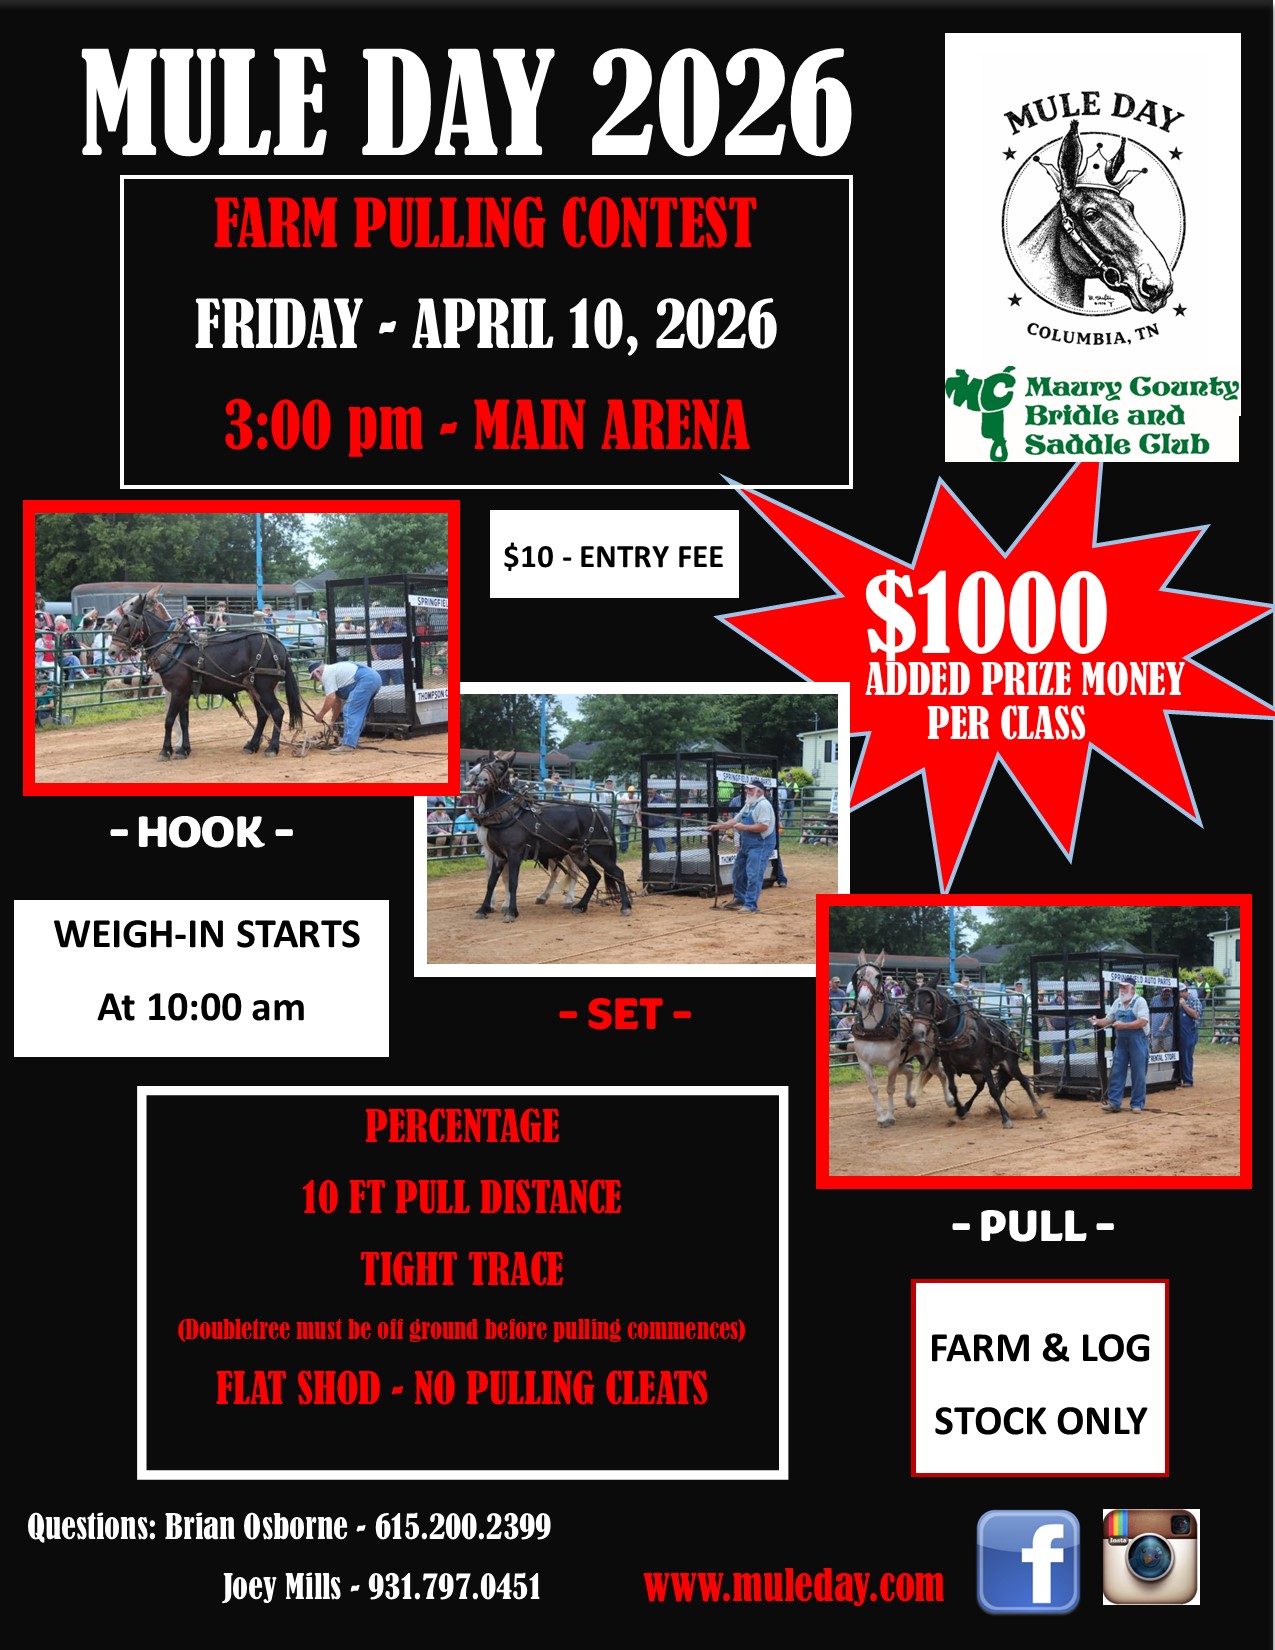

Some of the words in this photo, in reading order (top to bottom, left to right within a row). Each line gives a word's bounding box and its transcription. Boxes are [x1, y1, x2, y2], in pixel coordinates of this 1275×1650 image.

[82, 49, 327, 156] MULE
[362, 49, 555, 155] DAY
[592, 48, 852, 156] 2026
[1003, 90, 1102, 135] MULE
[1111, 91, 1186, 133] DAY
[214, 197, 337, 247] FARM
[354, 197, 546, 248] PULLING
[563, 197, 756, 248] CONTEST
[195, 298, 363, 348] FRIDAY
[412, 298, 553, 348] APRIL
[570, 298, 638, 356] 10,
[656, 298, 777, 349] 2026
[1026, 322, 1132, 346] COLUMBIA,
[1135, 322, 1160, 341] TN
[1025, 377, 1122, 401] Maury
[1129, 376, 1240, 401] County
[225, 399, 331, 450] 3:00
[348, 406, 423, 457] pm
[474, 399, 585, 449] MAIN
[601, 399, 750, 449] ARENA
[1025, 404, 1119, 426] Bridle
[1127, 404, 1186, 426] and
[1025, 434, 1131, 455] Saddle
[1139, 433, 1210, 455] Club
[504, 542, 553, 571] $10
[581, 546, 669, 567] ENTRY
[679, 546, 724, 567] FEE
[866, 569, 1107, 661] $1000
[865, 661, 970, 695] ADDED
[981, 661, 1071, 695] PRIZE
[1081, 661, 1186, 696] MONEY
[928, 706, 989, 740] PER
[1001, 705, 1086, 740] CLASS
[139, 816, 265, 848] HOOK
[54, 920, 223, 948] WEIGH-IN
[237, 920, 361, 948] STARTS
[1145, 976, 1156, 984] AUTO
[1158, 978, 1171, 986] PARTS
[98, 993, 135, 1021] At
[149, 993, 241, 1021] 10:00
[252, 1000, 304, 1021] am
[588, 998, 663, 1030] SET
[366, 1108, 559, 1143] PERCENTAGE
[303, 1180, 338, 1214] 10
[349, 1180, 385, 1214] FT
[396, 1180, 470, 1214] PULL
[480, 1179, 621, 1214] DISTANCE
[981, 1210, 1087, 1242] PULL
[361, 1251, 457, 1286] TIGHT
[469, 1251, 564, 1286] TRACE
[178, 1319, 290, 1342] (Doubletree
[297, 1319, 341, 1340] must
[349, 1319, 371, 1340] be
[378, 1319, 403, 1340] off
[410, 1319, 478, 1342] ground
[486, 1319, 547, 1340] before
[554, 1319, 621, 1342] pulling
[628, 1319, 745, 1342] commences)
[932, 1334, 1029, 1362] FARM
[1043, 1333, 1070, 1362] &
[1083, 1334, 1151, 1362] LOG
[216, 1371, 286, 1405] FLAT
[298, 1370, 380, 1405] SHOD
[415, 1370, 455, 1405] NO
[467, 1370, 594, 1405] PULLING
[606, 1370, 708, 1405] CLEATS
[935, 1407, 1046, 1435] STOCK
[1058, 1407, 1148, 1435] ONLY
[28, 1512, 155, 1543] Questions:
[165, 1512, 235, 1540] Brian
[244, 1512, 347, 1540] Osborne
[376, 1512, 551, 1540] 615.200.2399
[222, 1573, 277, 1603] Joey
[286, 1573, 341, 1600] Mills
[369, 1573, 540, 1600] 931.797.0451
[644, 1567, 944, 1606] www.muleday.com
